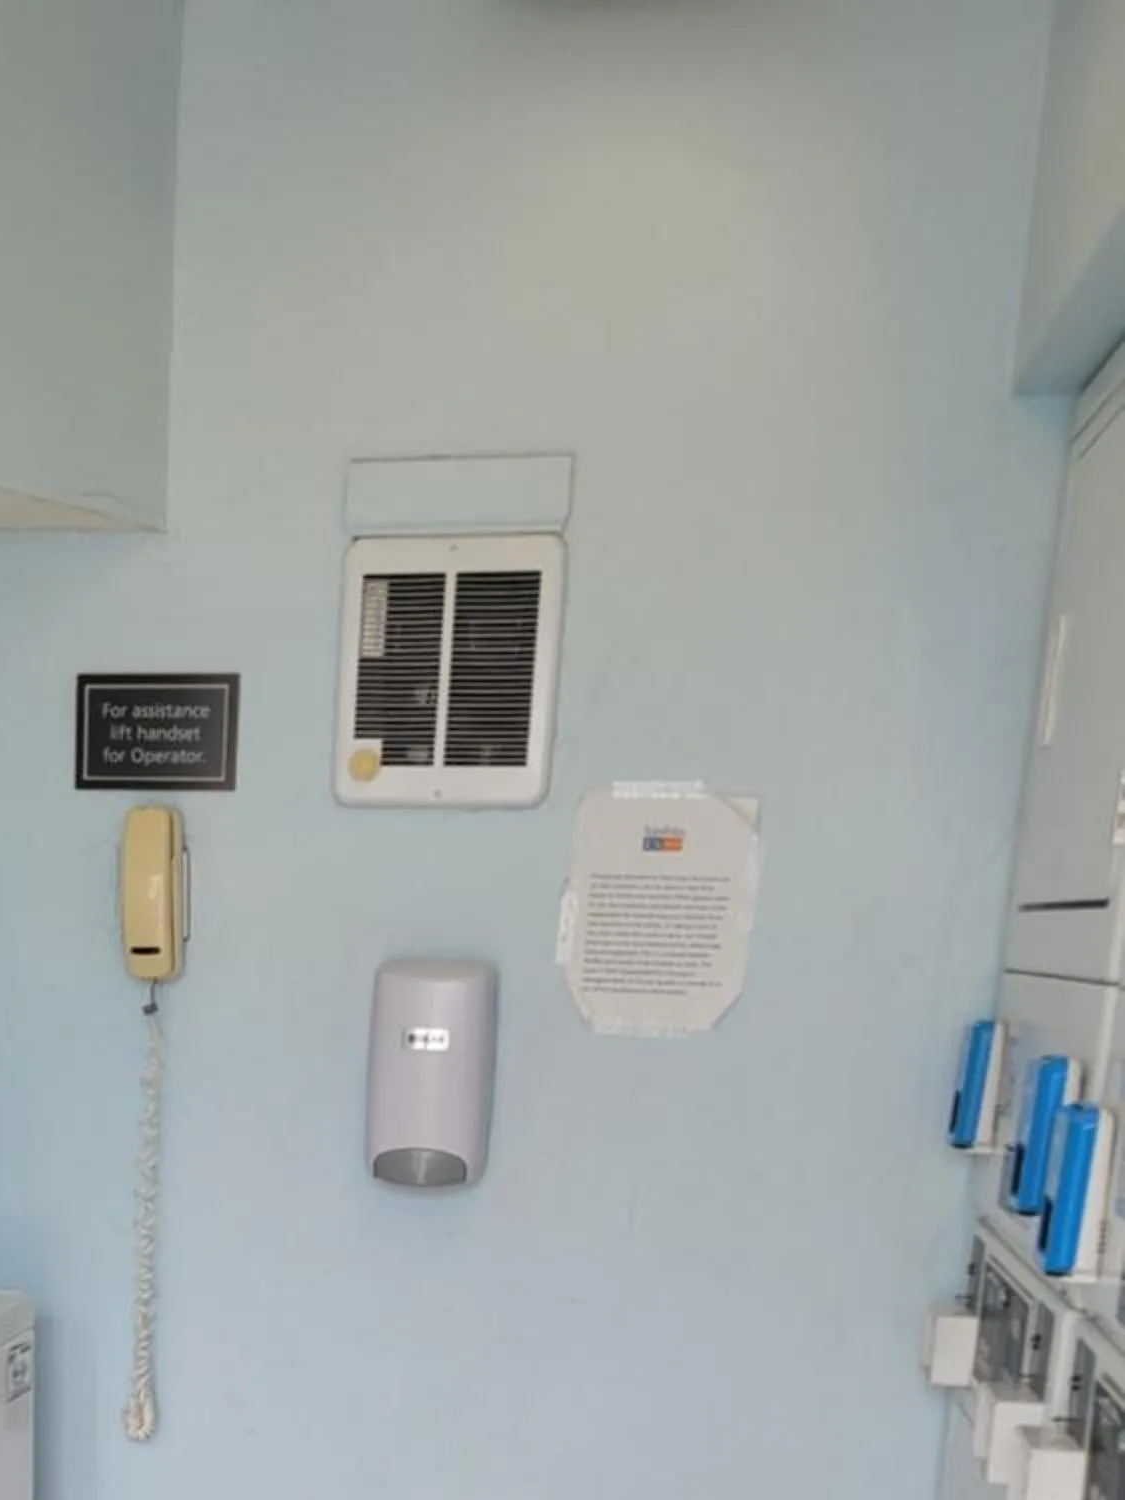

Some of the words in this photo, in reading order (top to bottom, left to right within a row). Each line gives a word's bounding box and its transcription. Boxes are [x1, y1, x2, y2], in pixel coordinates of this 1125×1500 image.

[102, 703, 127, 718] For
[133, 704, 210, 718] assistance
[111, 725, 132, 740] lift
[137, 726, 200, 741] handset
[103, 747, 126, 763] for
[131, 748, 206, 766] Operator.
